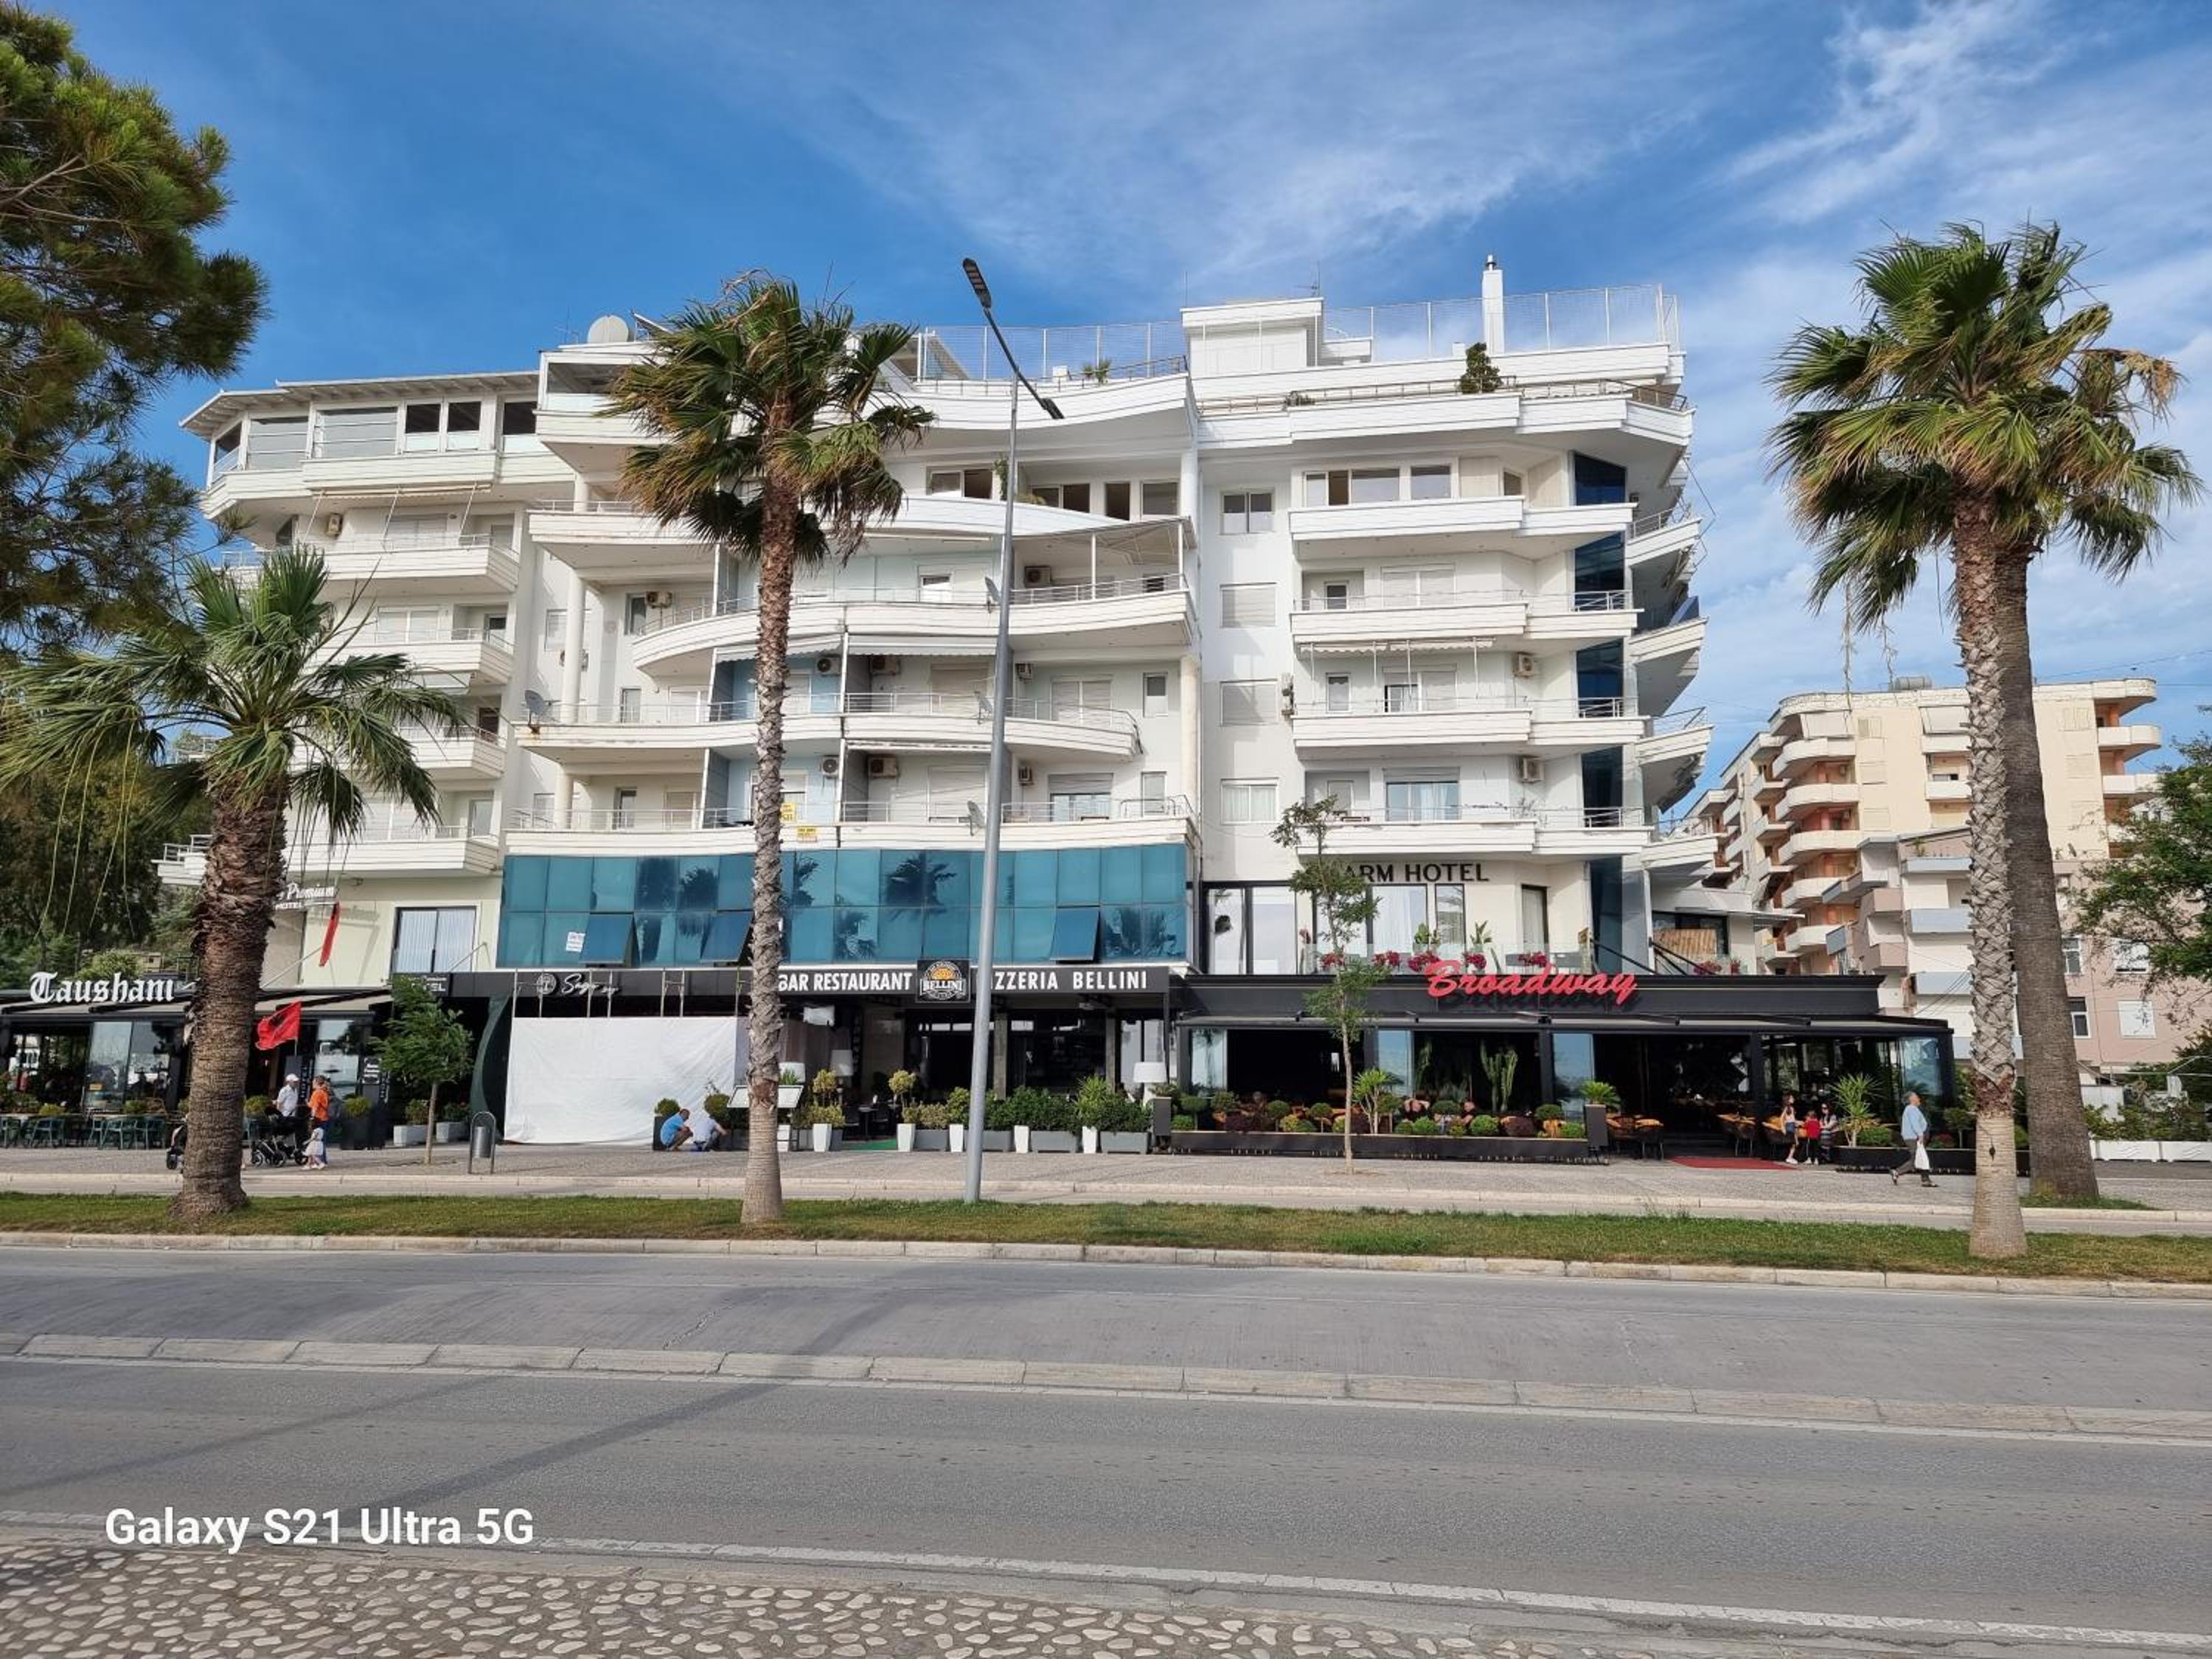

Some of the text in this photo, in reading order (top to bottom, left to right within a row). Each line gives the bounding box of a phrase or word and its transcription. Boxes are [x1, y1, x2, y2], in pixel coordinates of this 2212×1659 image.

[1405, 863, 1489, 882] HOTEL
[779, 973, 912, 991] BAR RESTAURANT
[1073, 971, 1146, 990] BELLINI
[1425, 956, 1636, 1004] Broadway
